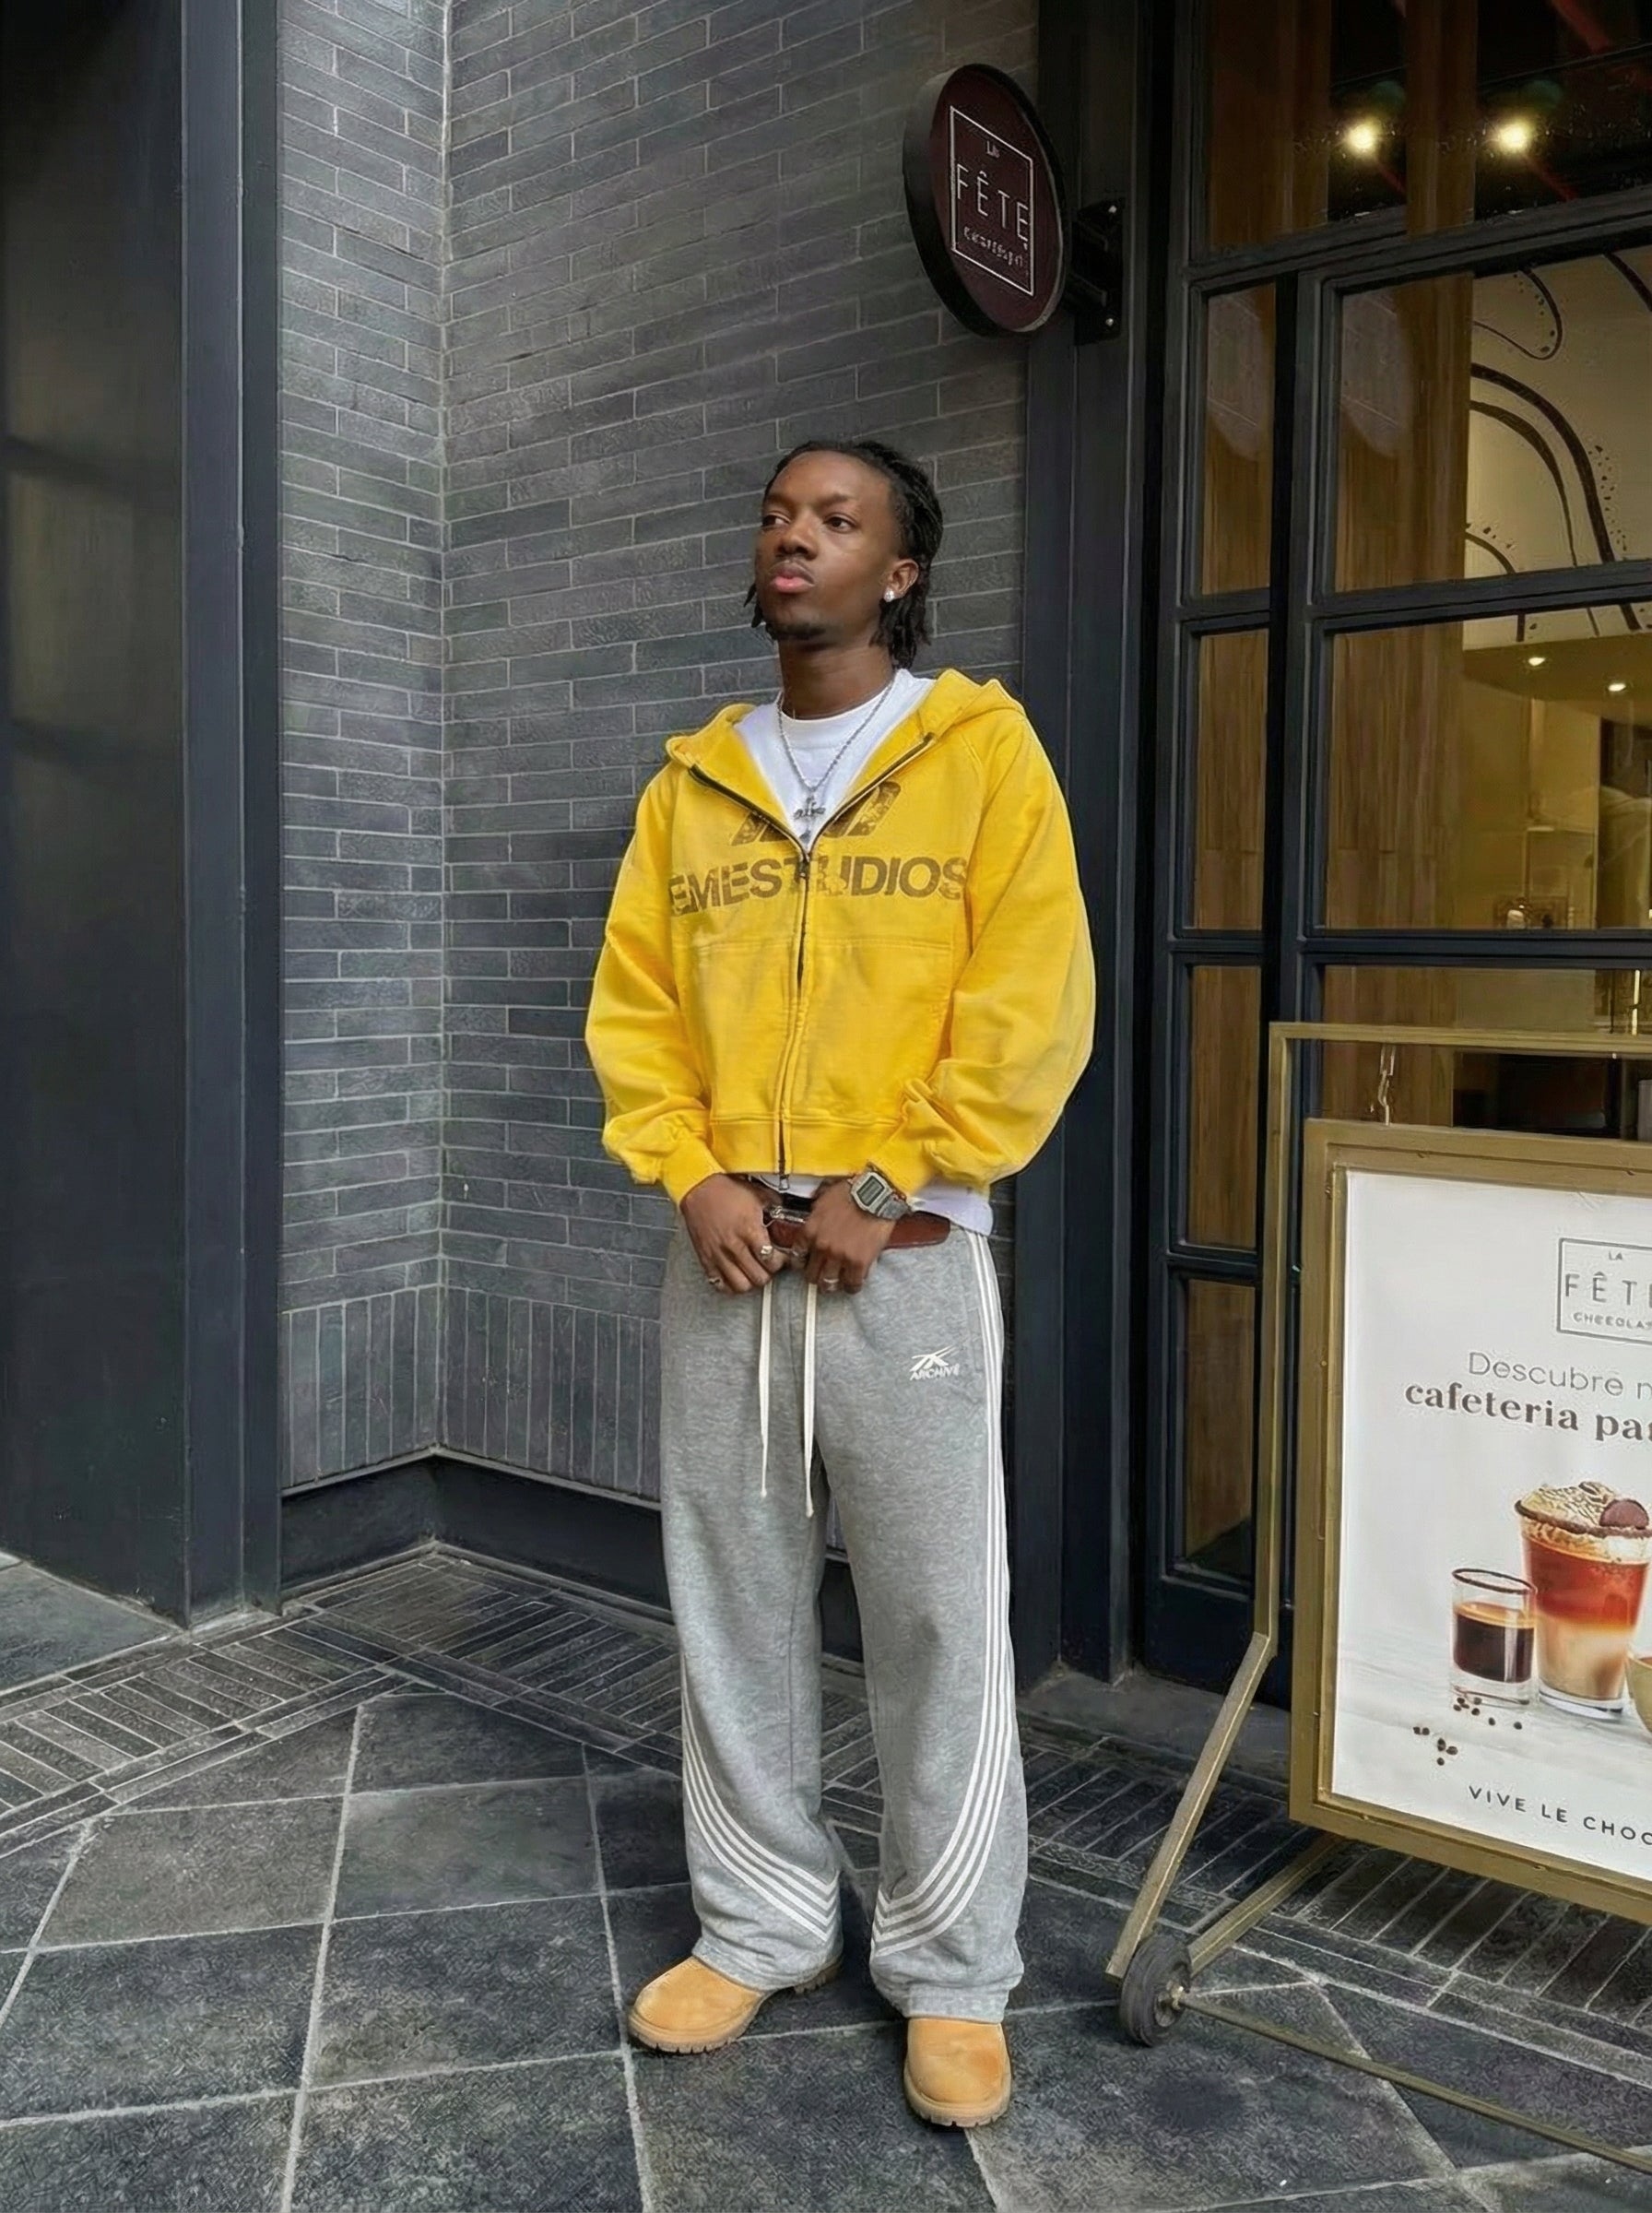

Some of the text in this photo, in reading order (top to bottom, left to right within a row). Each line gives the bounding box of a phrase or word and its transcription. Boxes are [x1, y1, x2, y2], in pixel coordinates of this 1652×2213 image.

[957, 163, 1029, 242] FÊTE
[1608, 1250, 1623, 1261] LA
[1469, 1352, 1623, 1396] Descubre
[1405, 1382, 1579, 1430] cafeteria
[1469, 1785, 1526, 1812] VIVE
[1541, 1804, 1567, 1823] LE
